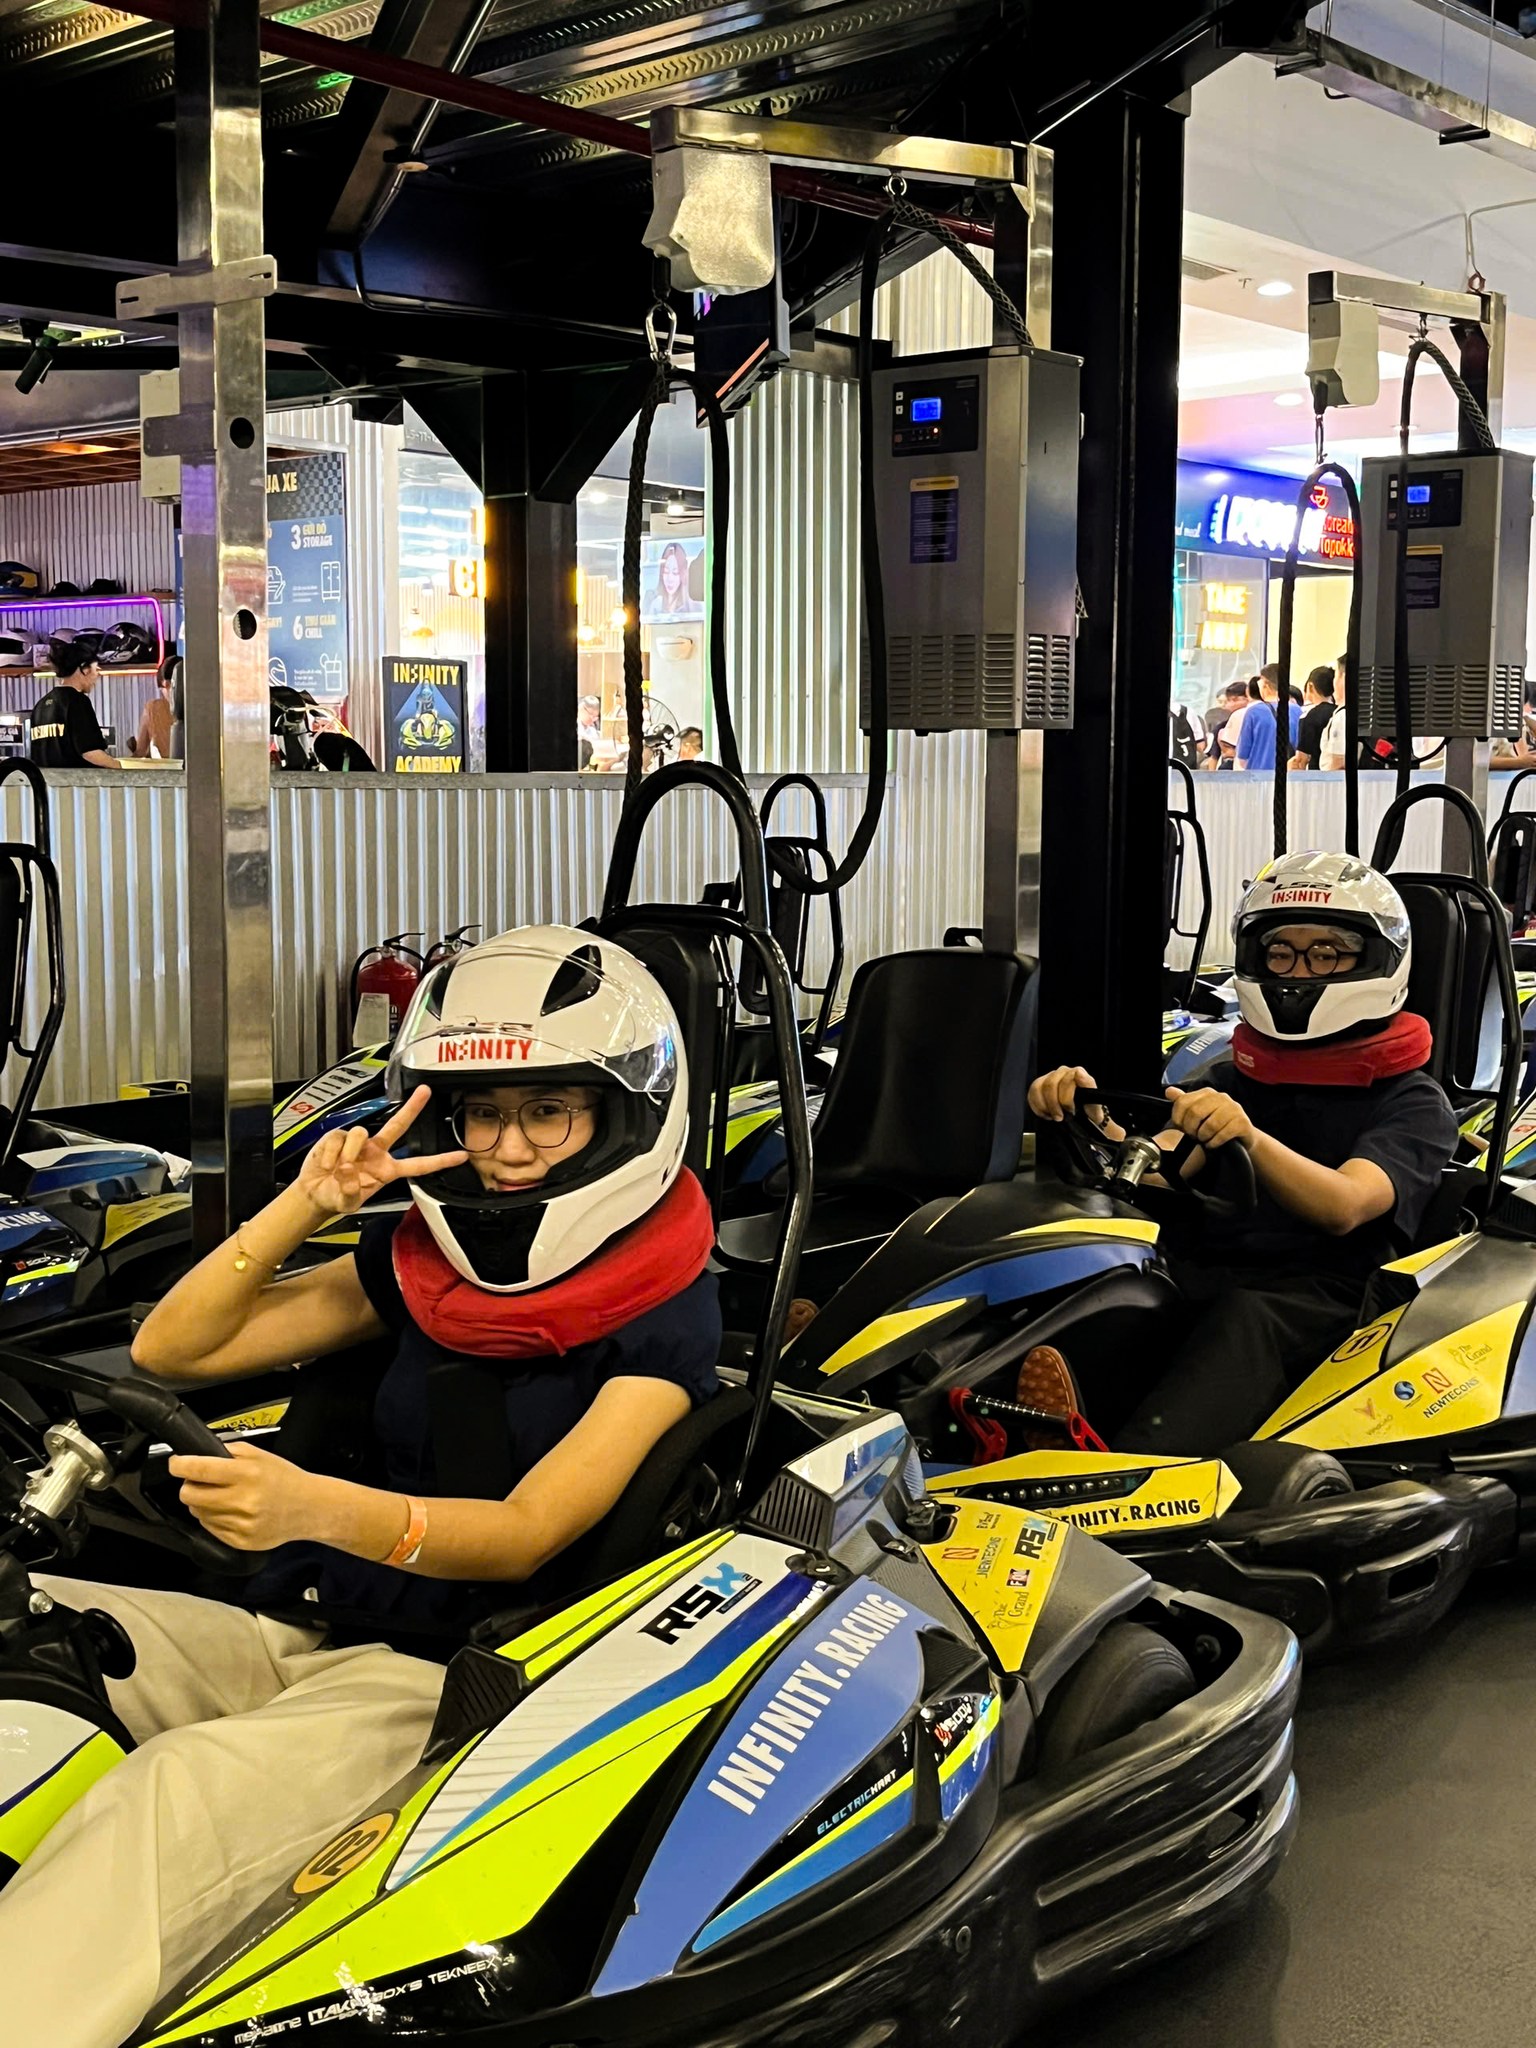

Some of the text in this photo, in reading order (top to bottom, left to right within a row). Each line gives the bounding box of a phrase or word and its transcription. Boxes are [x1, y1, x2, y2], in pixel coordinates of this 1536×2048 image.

[282, 471, 298, 492] XE
[291, 525, 301, 550] 3
[303, 535, 333, 548] STORAGE
[1320, 534, 1355, 558] Topokk
[293, 616, 304, 640] 6
[394, 663, 459, 685] INFINITY
[396, 756, 462, 773] ACADEMY
[1272, 890, 1332, 904] INFINITY
[438, 1039, 534, 1063] INFINITY
[1423, 1376, 1480, 1419] NEWTECONS
[308, 1829, 380, 1876] 02
